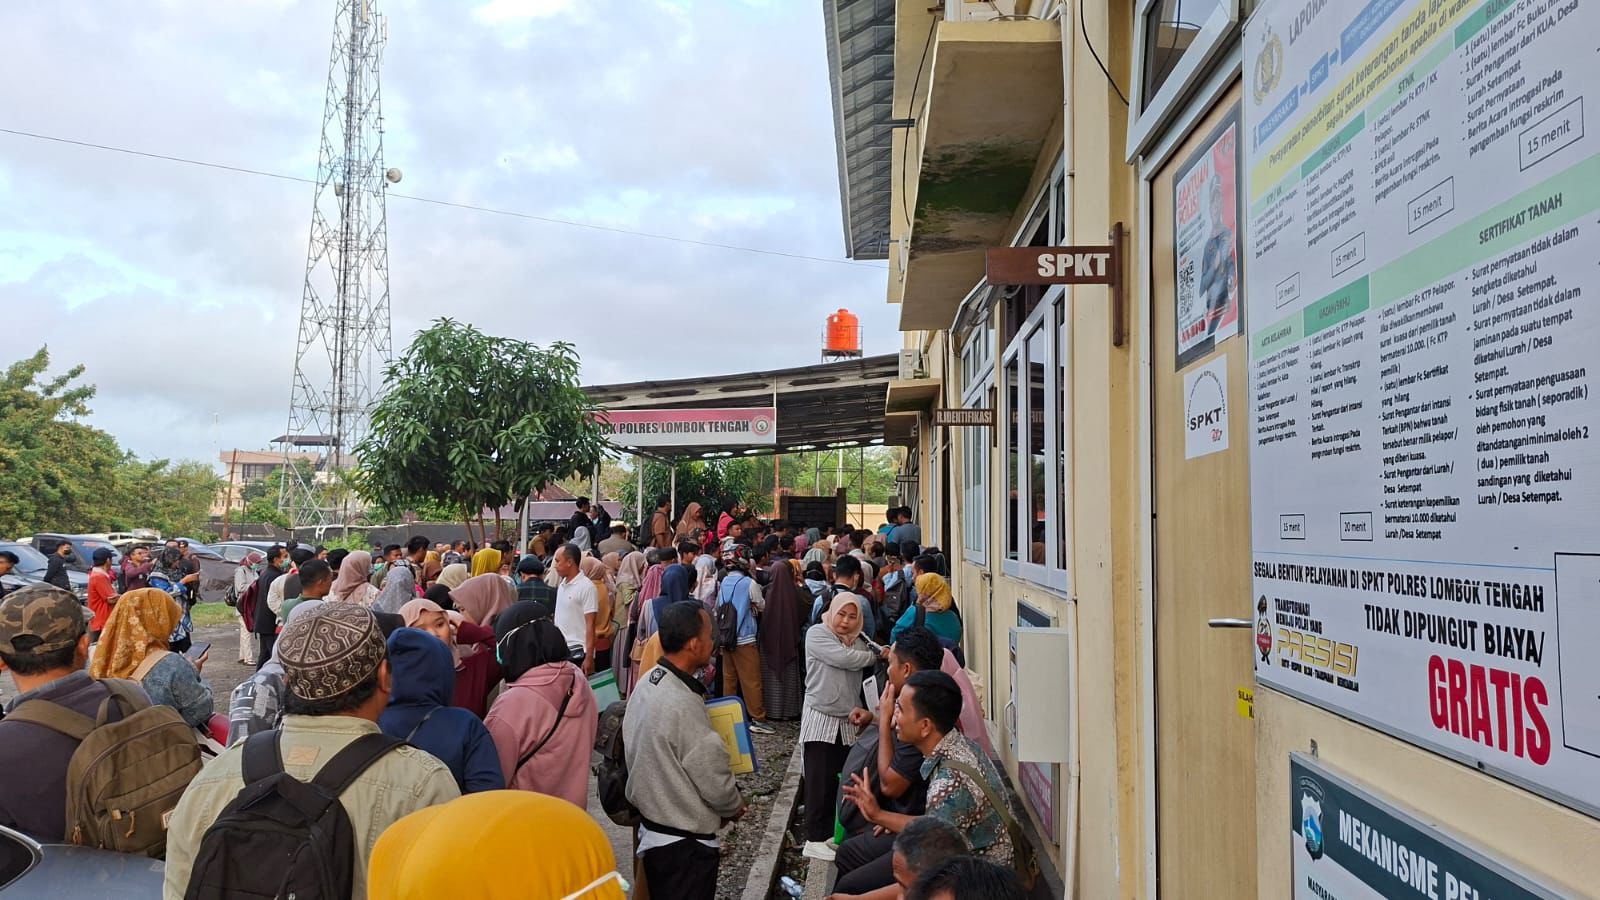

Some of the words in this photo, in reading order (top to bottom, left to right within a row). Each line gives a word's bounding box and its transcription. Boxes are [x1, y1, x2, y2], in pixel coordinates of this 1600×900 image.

[1466, 69, 1483, 89] Surat
[1484, 42, 1519, 76] Pengantar
[1520, 28, 1535, 48] dari
[1536, 15, 1556, 37] KUA,
[1558, 0, 1579, 20] Desa
[1470, 27, 1489, 53] (satu)
[1490, 8, 1515, 35] lembar
[1517, 0, 1525, 10] Fc
[1471, 44, 1490, 70] (satu)
[1490, 26, 1516, 53] lembar
[1517, 19, 1525, 32] Fc
[1526, 0, 1547, 25] Buku
[1336, 78, 1353, 104] surat
[1355, 36, 1398, 86] keterangan
[1401, 10, 1425, 42] tanda
[1366, 48, 1407, 96] permohonan
[1409, 22, 1436, 54] apabila
[1439, 9, 1446, 27] di
[1467, 84, 1486, 105] Lurah
[1487, 59, 1520, 91] Setempat
[1467, 103, 1484, 123] Surat
[1485, 76, 1525, 110] Pernyataan
[1467, 120, 1487, 139] Berita
[1488, 106, 1507, 126] Acara
[1542, 69, 1562, 90] Pada
[1469, 124, 1509, 158] pengemban
[1509, 106, 1532, 130] fungsi
[1533, 89, 1563, 115] reskrim
[1527, 136, 1538, 154] 15
[1541, 119, 1570, 146] menit
[1413, 206, 1421, 221] 15
[1422, 195, 1441, 215] menit
[1479, 210, 1526, 244] SERTIFIKAT
[1527, 192, 1562, 220] TANAH
[1038, 253, 1109, 277] SPKT
[1335, 255, 1341, 267] 15
[1342, 247, 1356, 260] menit
[1472, 263, 1489, 280] Surat
[1490, 247, 1530, 275] pernyataan
[1531, 236, 1551, 254] tidak
[1552, 226, 1578, 246] dalam
[1471, 278, 1502, 297] Sengketa
[1472, 297, 1490, 314] Lurah
[1496, 291, 1514, 305] Desa
[1517, 274, 1557, 298] Setempat.
[1473, 316, 1491, 331] Surat
[1492, 303, 1532, 327] pernyataan
[1533, 293, 1553, 311] tidak
[1554, 287, 1580, 304] dalam
[1473, 332, 1500, 351] jaminan
[1501, 325, 1519, 342] pada
[1520, 319, 1541, 334] suatu
[1542, 308, 1572, 327] tempat
[1473, 346, 1505, 365] diketahui
[1505, 341, 1526, 356] Lurah
[1533, 335, 1552, 349] Desa
[1474, 365, 1508, 383] Setempat.
[1475, 387, 1493, 400] Surat
[1494, 379, 1535, 398] pernyataan
[1535, 367, 1585, 389] penguasaan
[1190, 407, 1221, 431] SPKT
[1475, 405, 1498, 417] bidang
[1499, 399, 1513, 412] fisik
[1514, 395, 1536, 409] tanah
[1542, 385, 1583, 405] seporadik
[619, 421, 658, 434] POLRES
[661, 421, 705, 433] LOMBOK
[708, 420, 749, 432] TENGAH
[1476, 422, 1490, 434] oleh
[1491, 417, 1526, 434] pemohon
[1526, 415, 1545, 428] yang
[1476, 434, 1528, 452] ditandatangani
[1529, 428, 1561, 444] minimal
[1562, 426, 1581, 440] oleh
[1477, 475, 1512, 488] sandingan
[1512, 474, 1530, 486] yang
[1534, 468, 1571, 482] diketahui
[1481, 457, 1494, 469] dua
[1499, 453, 1526, 469] pemilik
[1526, 450, 1549, 464] tanah
[1478, 492, 1496, 504] Lurah
[1502, 492, 1520, 503] Desa
[1521, 490, 1562, 504] Setempat.
[1344, 521, 1350, 531] 20
[1351, 522, 1366, 531] menit
[1254, 561, 1276, 578] SEGALA
[1278, 563, 1303, 581] BENTUK
[1305, 566, 1347, 587] PELAYANAN
[1350, 570, 1358, 588] DI
[1362, 570, 1383, 591] SPKT
[1387, 572, 1426, 597] POLRES
[1430, 576, 1480, 604] LOMBOK
[1484, 581, 1543, 612] TENGAH
[1364, 604, 1400, 635] TIDAK
[1403, 610, 1477, 651] DIPUNGUT
[1483, 622, 1544, 667] BIAYA/
[1428, 654, 1550, 765] GRATIS
[1339, 809, 1438, 900] MEKANISME
